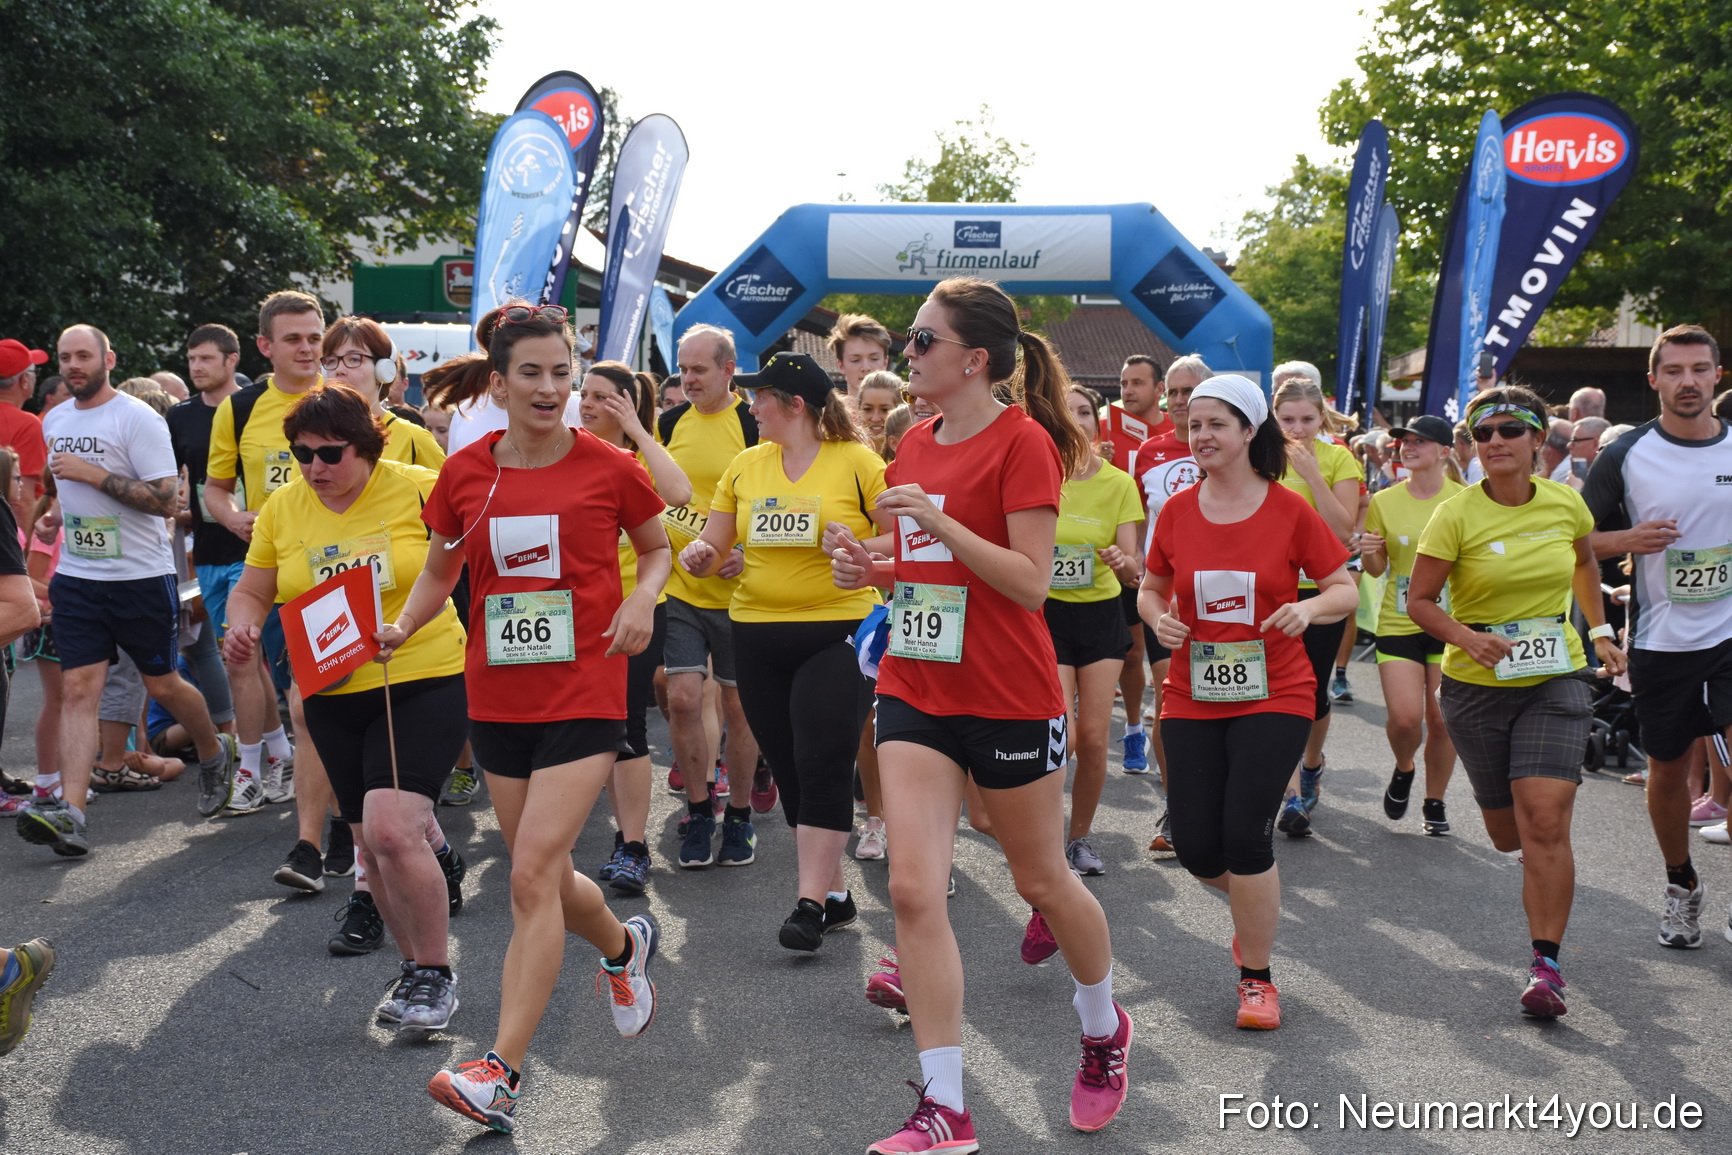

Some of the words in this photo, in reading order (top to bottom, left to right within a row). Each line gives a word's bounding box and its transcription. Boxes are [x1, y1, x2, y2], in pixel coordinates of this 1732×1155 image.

[1510, 130, 1617, 170] Hervis
[1523, 164, 1563, 173] SPORTS
[632, 139, 667, 240] Fischer
[646, 152, 673, 235] AUTOMOBILE
[1355, 146, 1379, 250] Fischer
[964, 231, 998, 240] Fischer
[936, 249, 1042, 269] firmenlauf
[736, 282, 793, 297] Fischer
[1482, 197, 1597, 366] TMOVIN
[53, 437, 104, 454] GRADL
[756, 513, 809, 532] 2005
[74, 530, 106, 547] 943
[911, 533, 931, 546] DEHN
[517, 552, 538, 563] DEHN
[1053, 560, 1085, 576] 231
[1675, 564, 1728, 587] 2278
[549, 609, 567, 617] 2019
[1216, 600, 1236, 610] DEHN
[326, 623, 341, 641] DEHN
[501, 617, 551, 644] 466
[902, 610, 942, 640] 519
[503, 645, 525, 653] Ascher
[917, 639, 937, 647] Hanna
[318, 657, 339, 673] DEHN
[1509, 660, 1535, 669] Schneck
[1203, 664, 1248, 685] 488
[1236, 684, 1260, 692] Brigitte
[995, 748, 1040, 760] hummel
